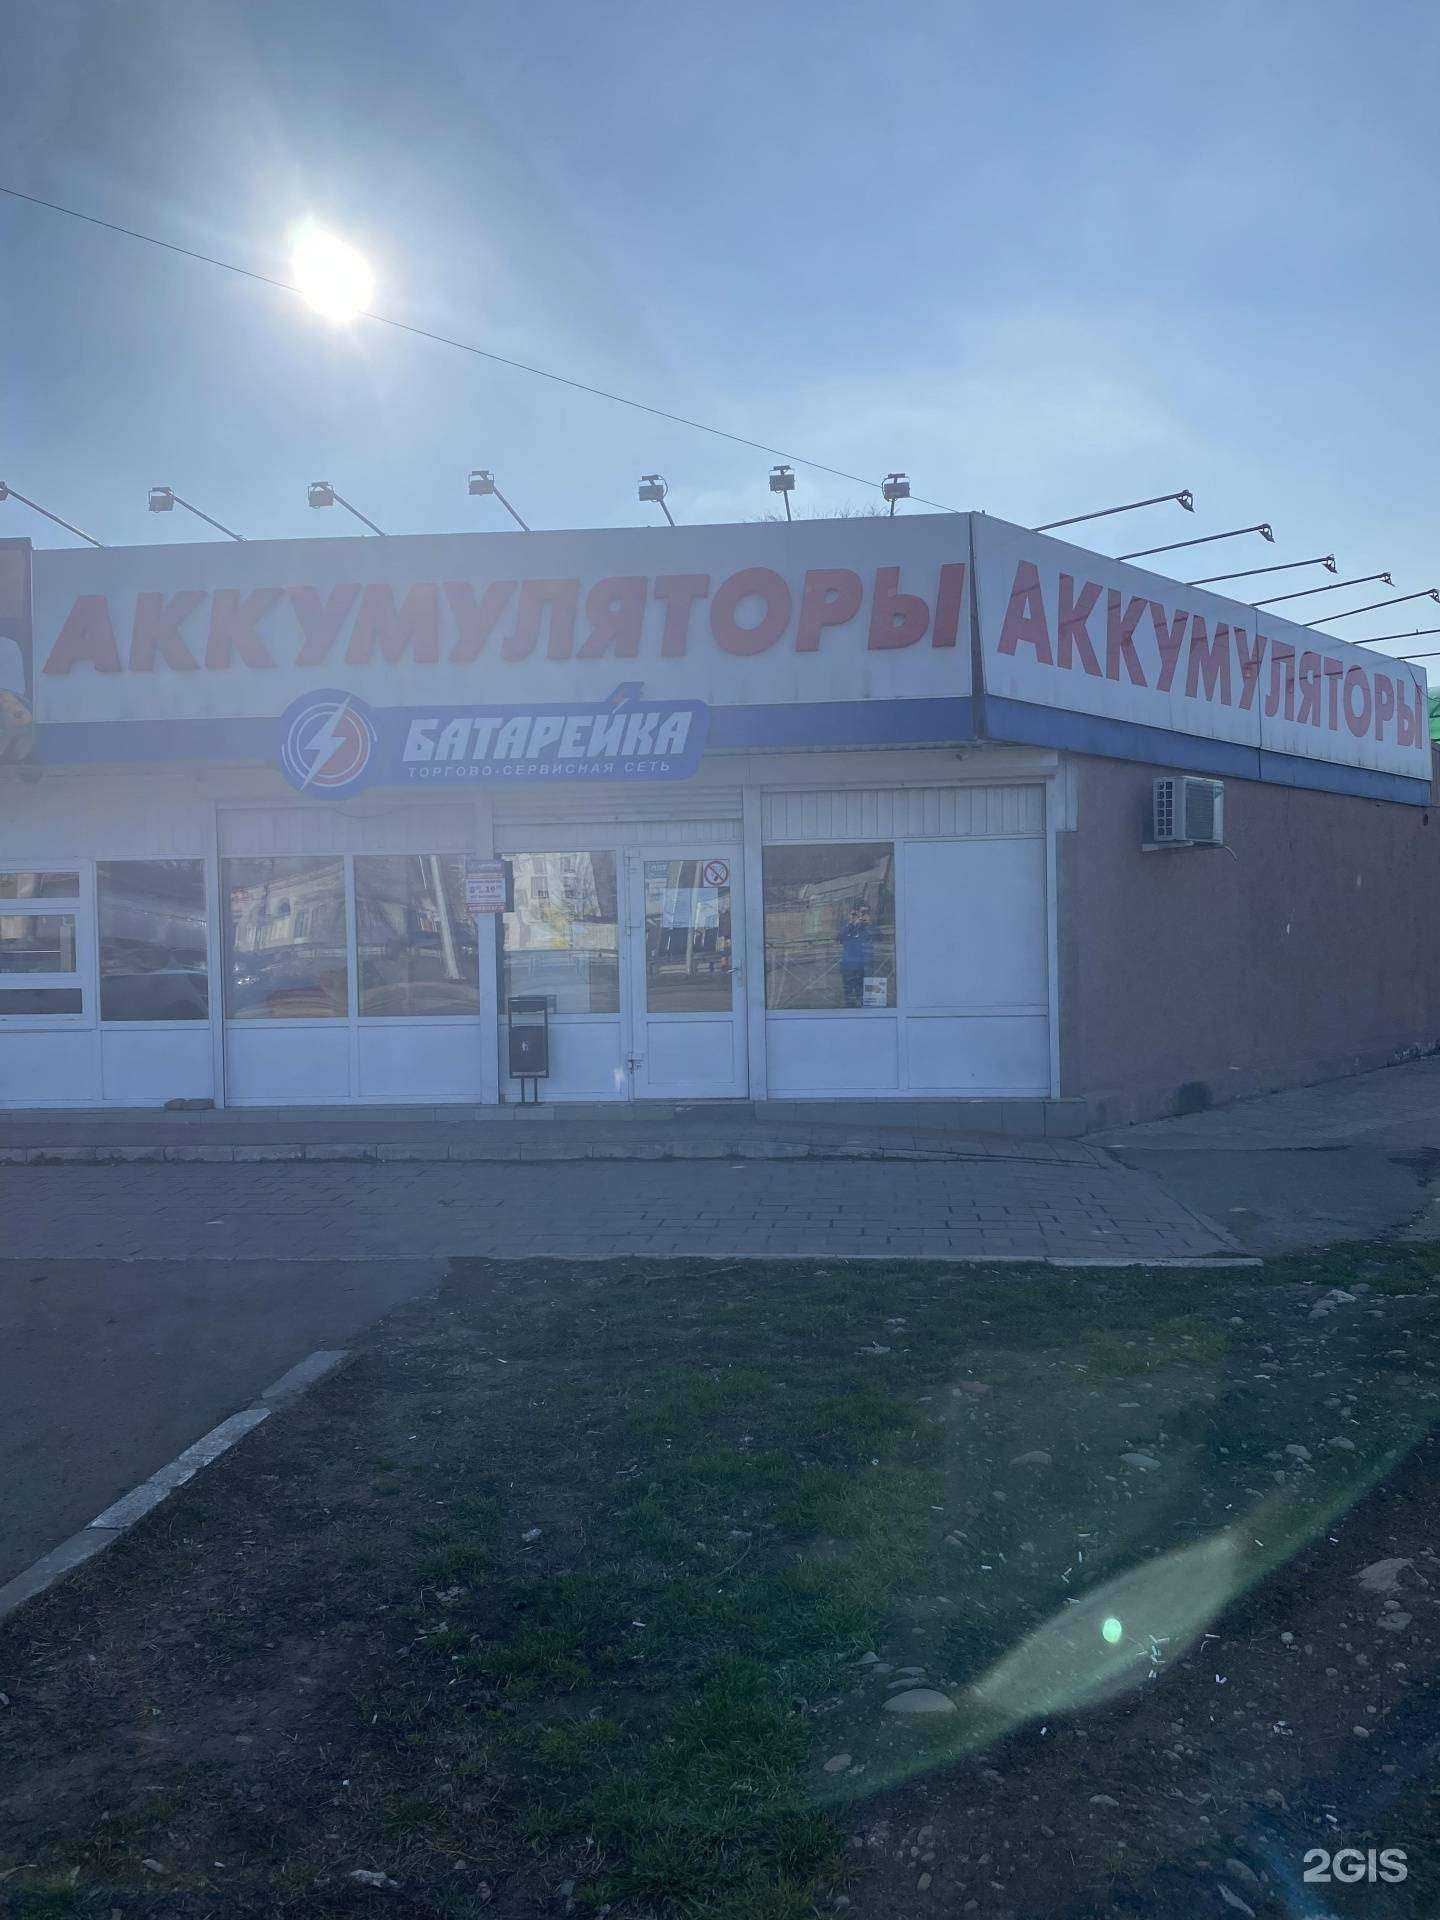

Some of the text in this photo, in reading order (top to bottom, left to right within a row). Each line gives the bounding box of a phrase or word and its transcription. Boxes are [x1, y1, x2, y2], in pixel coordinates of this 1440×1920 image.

[43, 563, 966, 674] АККУМУЛЯТОРЫ
[997, 560, 1423, 749] АККУМУЛЯТОРЫ
[402, 705, 693, 762] БАТАРЕЙКА
[624, 760, 671, 773] СЕТЬ
